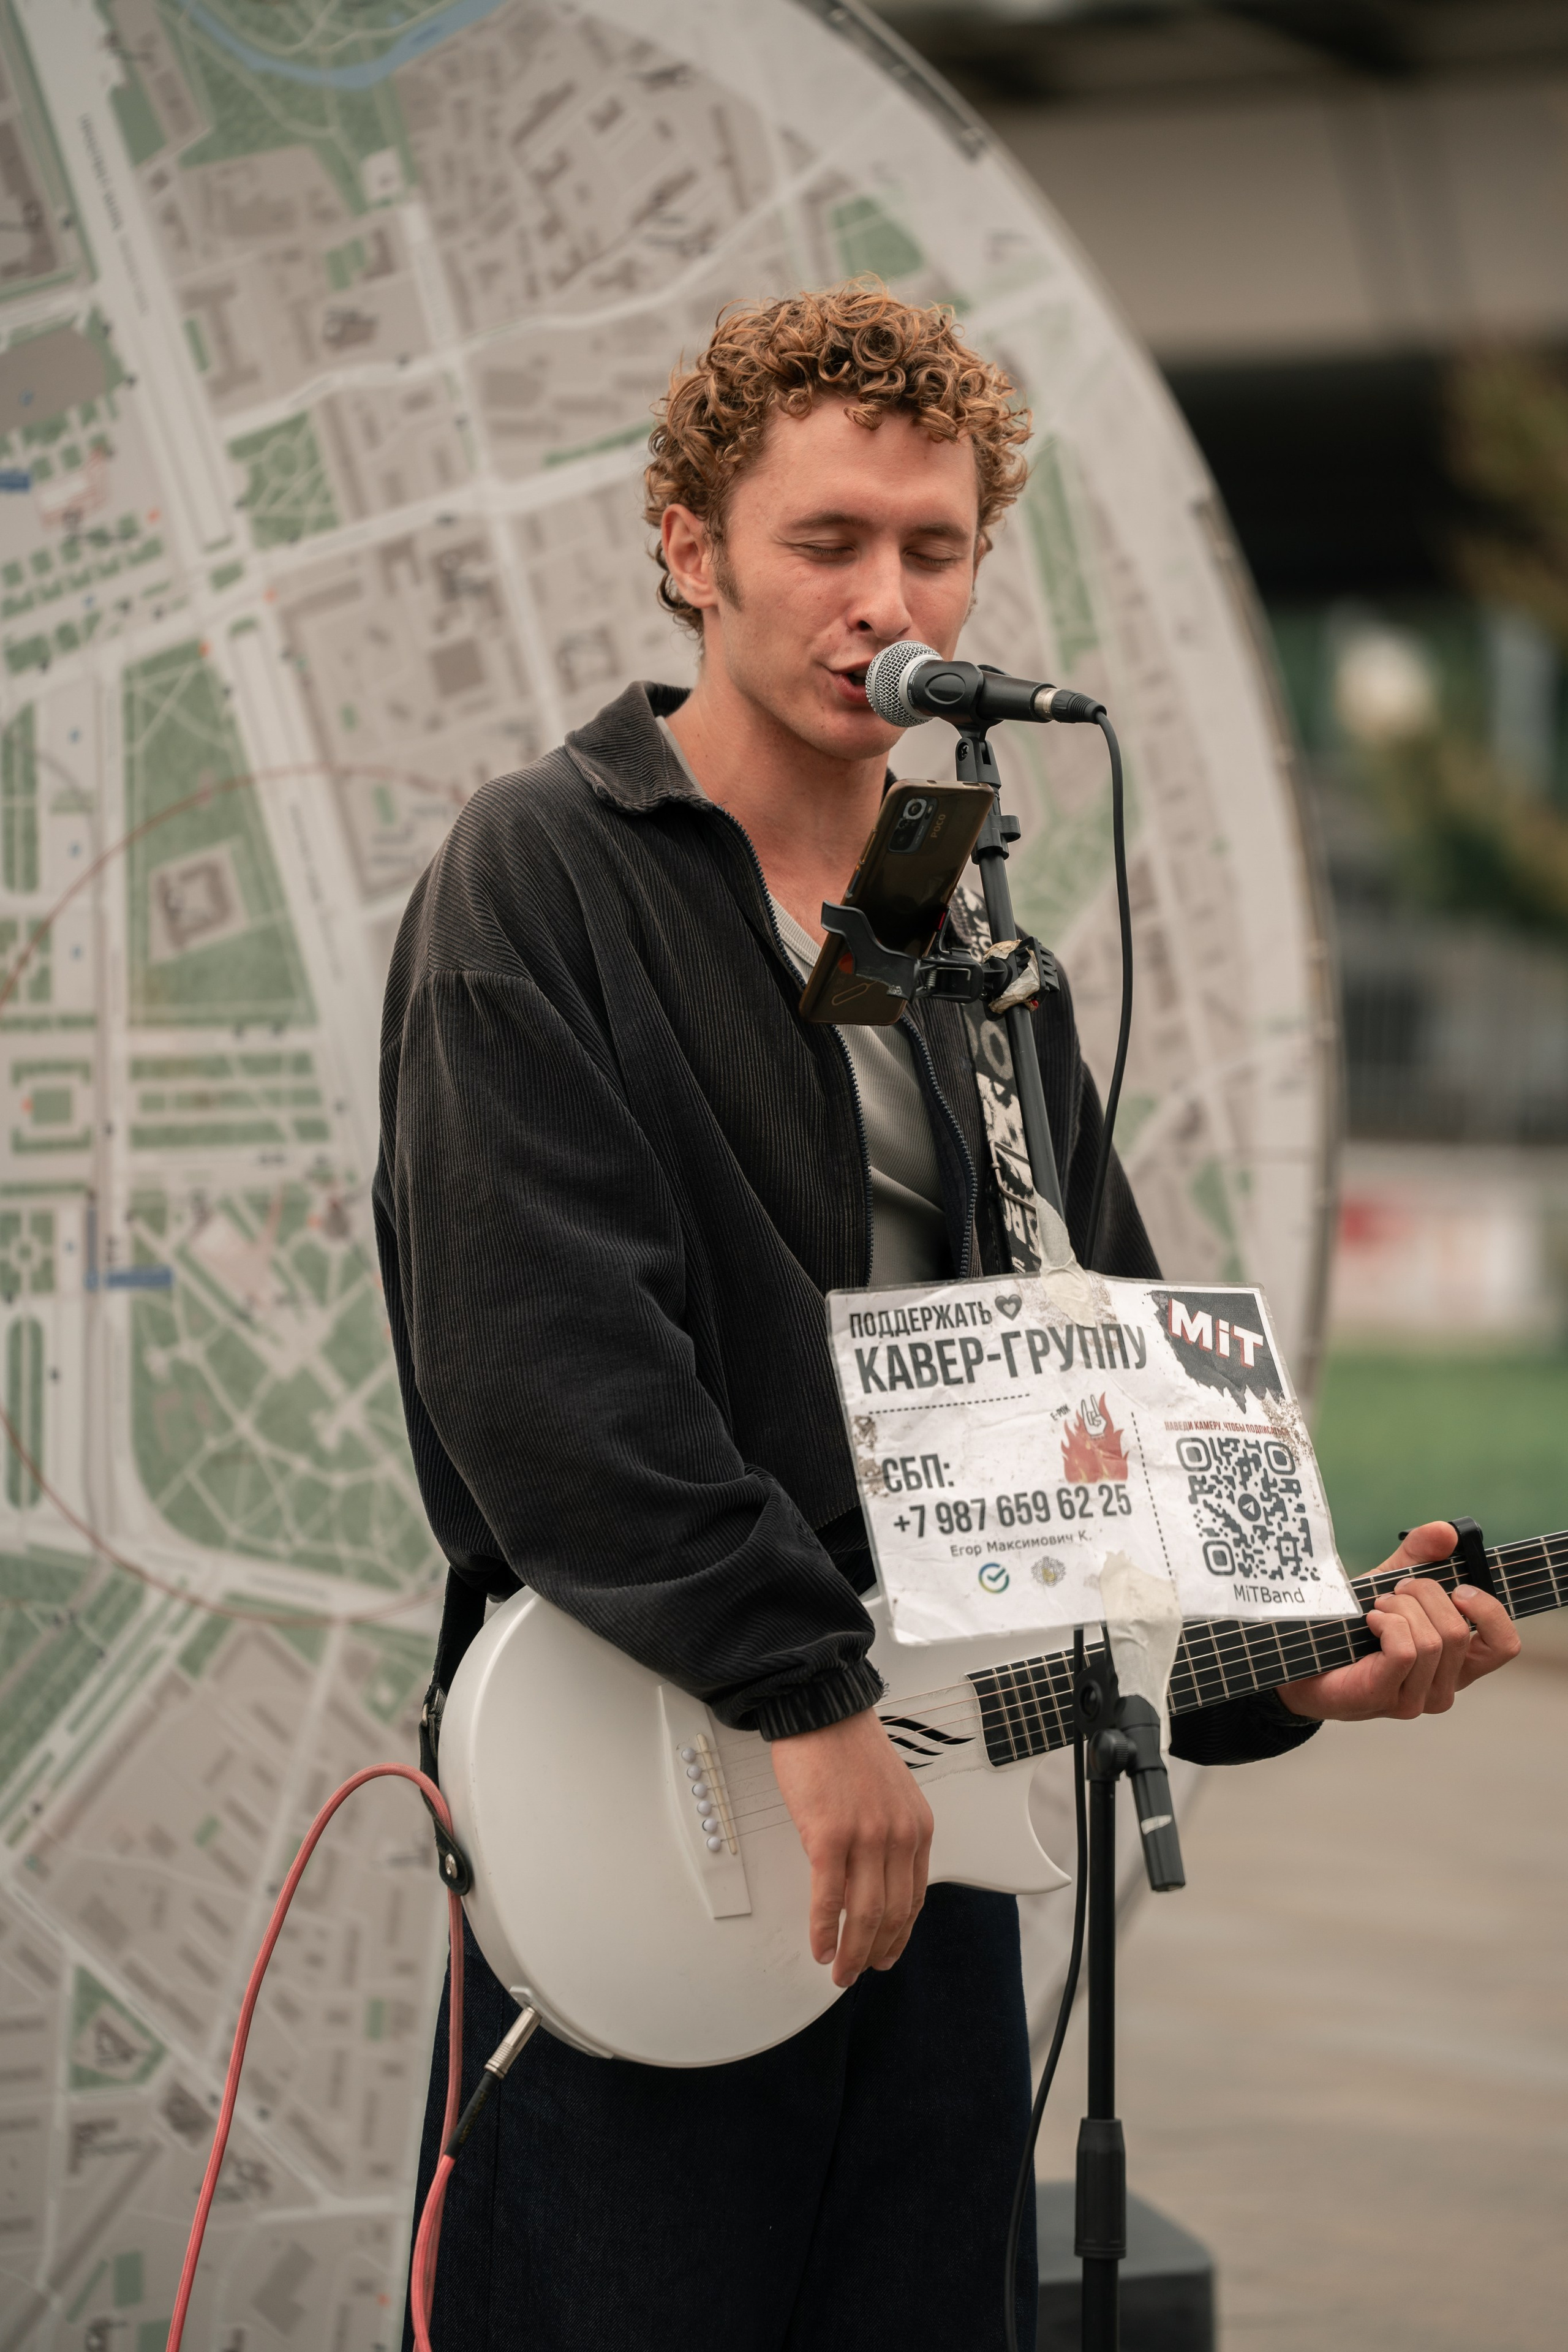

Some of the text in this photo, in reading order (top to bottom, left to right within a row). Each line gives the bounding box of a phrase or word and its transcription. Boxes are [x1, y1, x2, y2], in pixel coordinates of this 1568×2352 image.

[930, 814, 946, 838] POCO
[850, 1302, 992, 1338] ПОДДЕРЖАТЬ
[1168, 1298, 1264, 1369] MiT
[854, 1323, 1147, 1394] КАВЕР-ГРУППУ
[1164, 1421, 1193, 1431] НАВЕДИ
[1194, 1421, 1224, 1431] КАМЕРУ,
[1224, 1422, 1246, 1433] ЧТОБЫ
[882, 1453, 954, 1493] СБП:
[894, 1484, 1132, 1538] +7 987 659 62 25
[950, 1529, 1093, 1557] Егор Максимович К.
[1234, 1584, 1305, 1604] MiTBand
